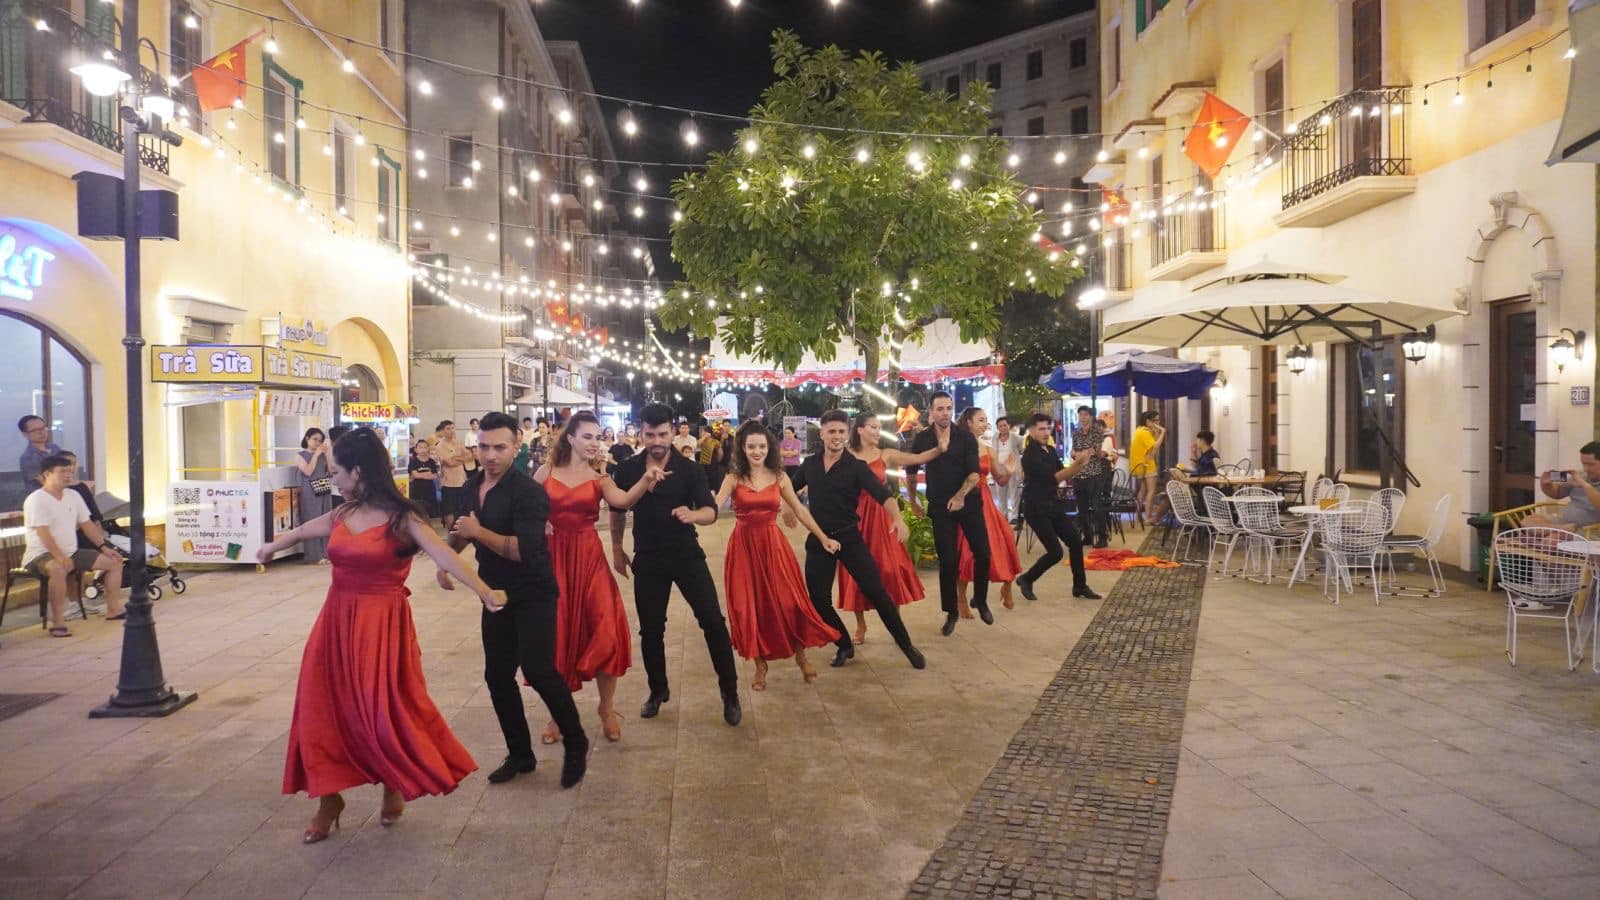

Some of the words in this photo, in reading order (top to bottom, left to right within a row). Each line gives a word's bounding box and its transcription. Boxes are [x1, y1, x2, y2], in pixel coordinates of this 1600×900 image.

[159, 349, 198, 374] Trà
[211, 350, 253, 374] Sữa
[269, 351, 288, 375] Trà
[292, 354, 311, 377] Sữa
